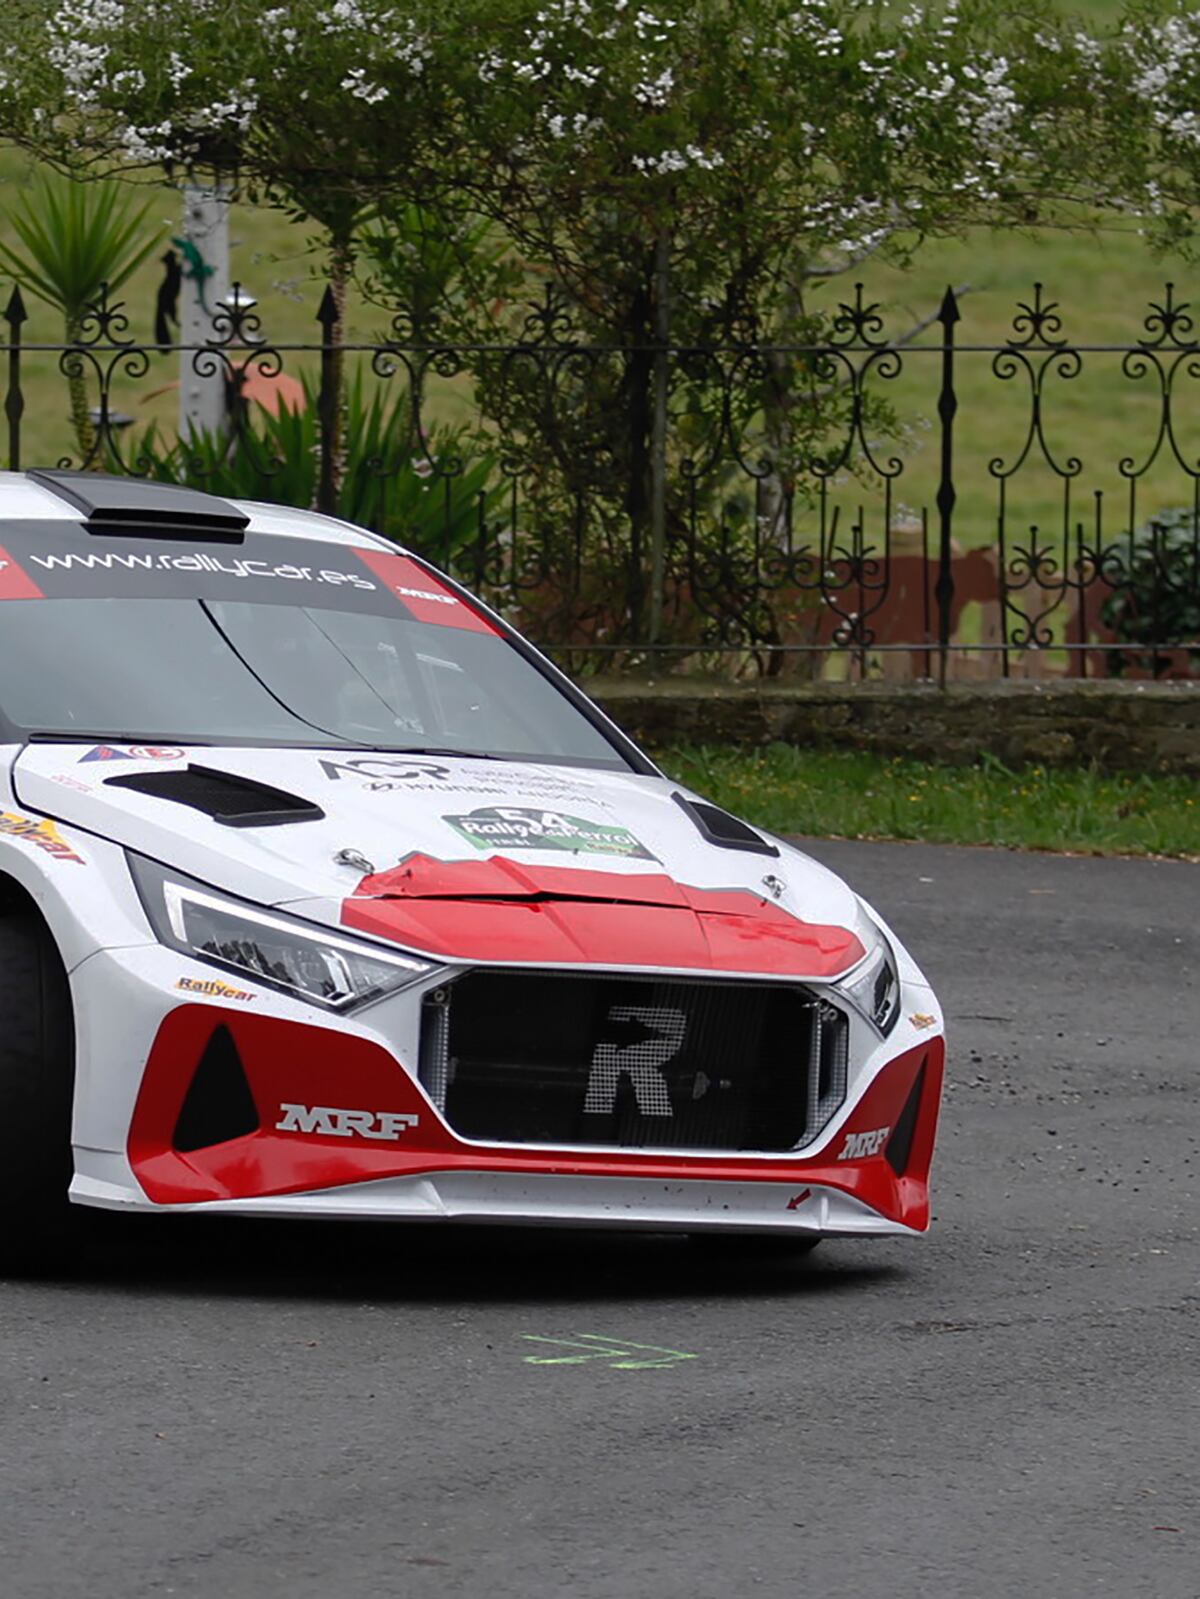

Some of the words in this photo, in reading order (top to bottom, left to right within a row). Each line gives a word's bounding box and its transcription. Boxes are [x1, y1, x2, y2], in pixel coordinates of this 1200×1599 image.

[30, 553, 376, 591] www.rallycar.es
[583, 1006, 687, 1117] R
[275, 1103, 419, 1140] MRF
[837, 1126, 890, 1160] MRF
